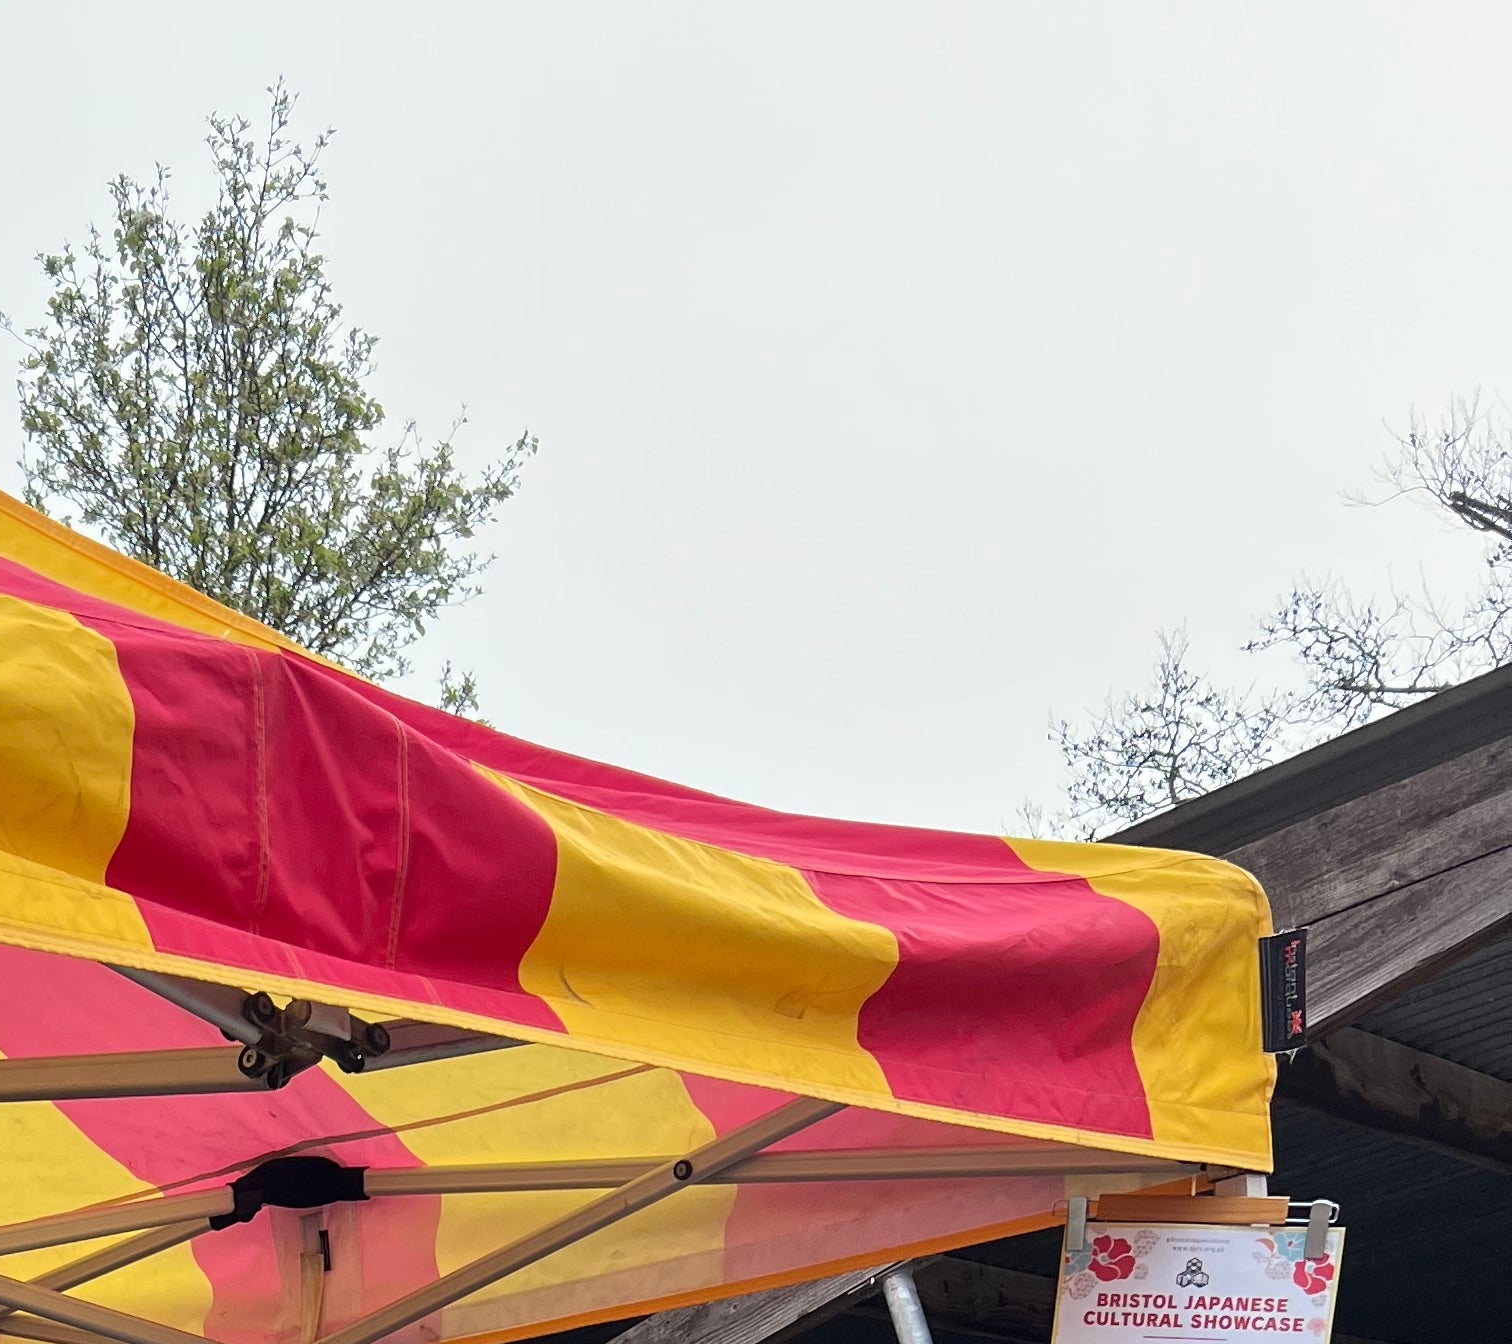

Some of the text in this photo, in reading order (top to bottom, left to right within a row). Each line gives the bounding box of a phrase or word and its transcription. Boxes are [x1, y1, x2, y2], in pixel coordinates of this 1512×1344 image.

[1097, 1293, 1289, 1312] BRISTOL JAPANESE
[1083, 1311, 1305, 1332] CULTURAL SHOWCASE
